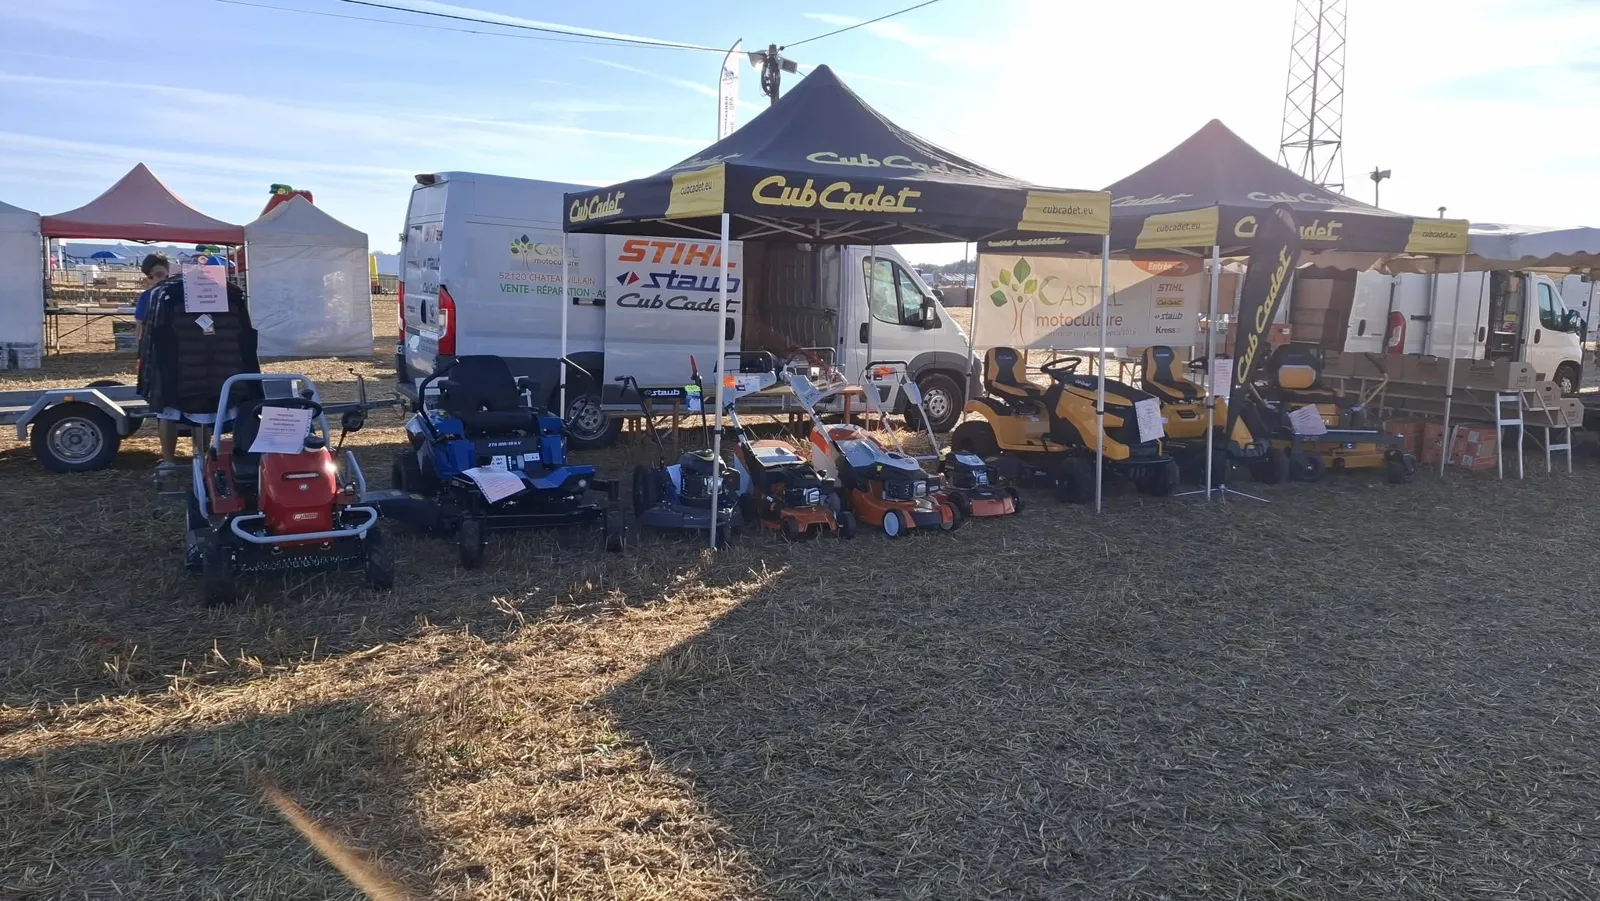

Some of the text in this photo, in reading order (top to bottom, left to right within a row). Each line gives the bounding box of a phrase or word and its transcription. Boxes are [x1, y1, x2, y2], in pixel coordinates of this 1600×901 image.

[806, 152, 881, 167] Cub
[680, 180, 713, 195] cubcadet.eu
[752, 175, 921, 213] Cub Cadet
[1247, 191, 1300, 203] Cub
[570, 191, 625, 222] Cub Cadet
[1042, 205, 1093, 215] cubcadet.eu
[1156, 221, 1200, 233] cubcadet.eu
[618, 239, 737, 268] STIHL
[1148, 262, 1174, 271] Entrée
[499, 272, 527, 281] 52120
[641, 269, 741, 293] staub
[500, 283, 529, 294] VENTE
[1157, 284, 1184, 292] STIHL
[1256, 244, 1292, 334] Cadet
[617, 293, 741, 313] Cub Cadet
[1155, 326, 1176, 334] Kress
[1238, 333, 1258, 384] Cub
